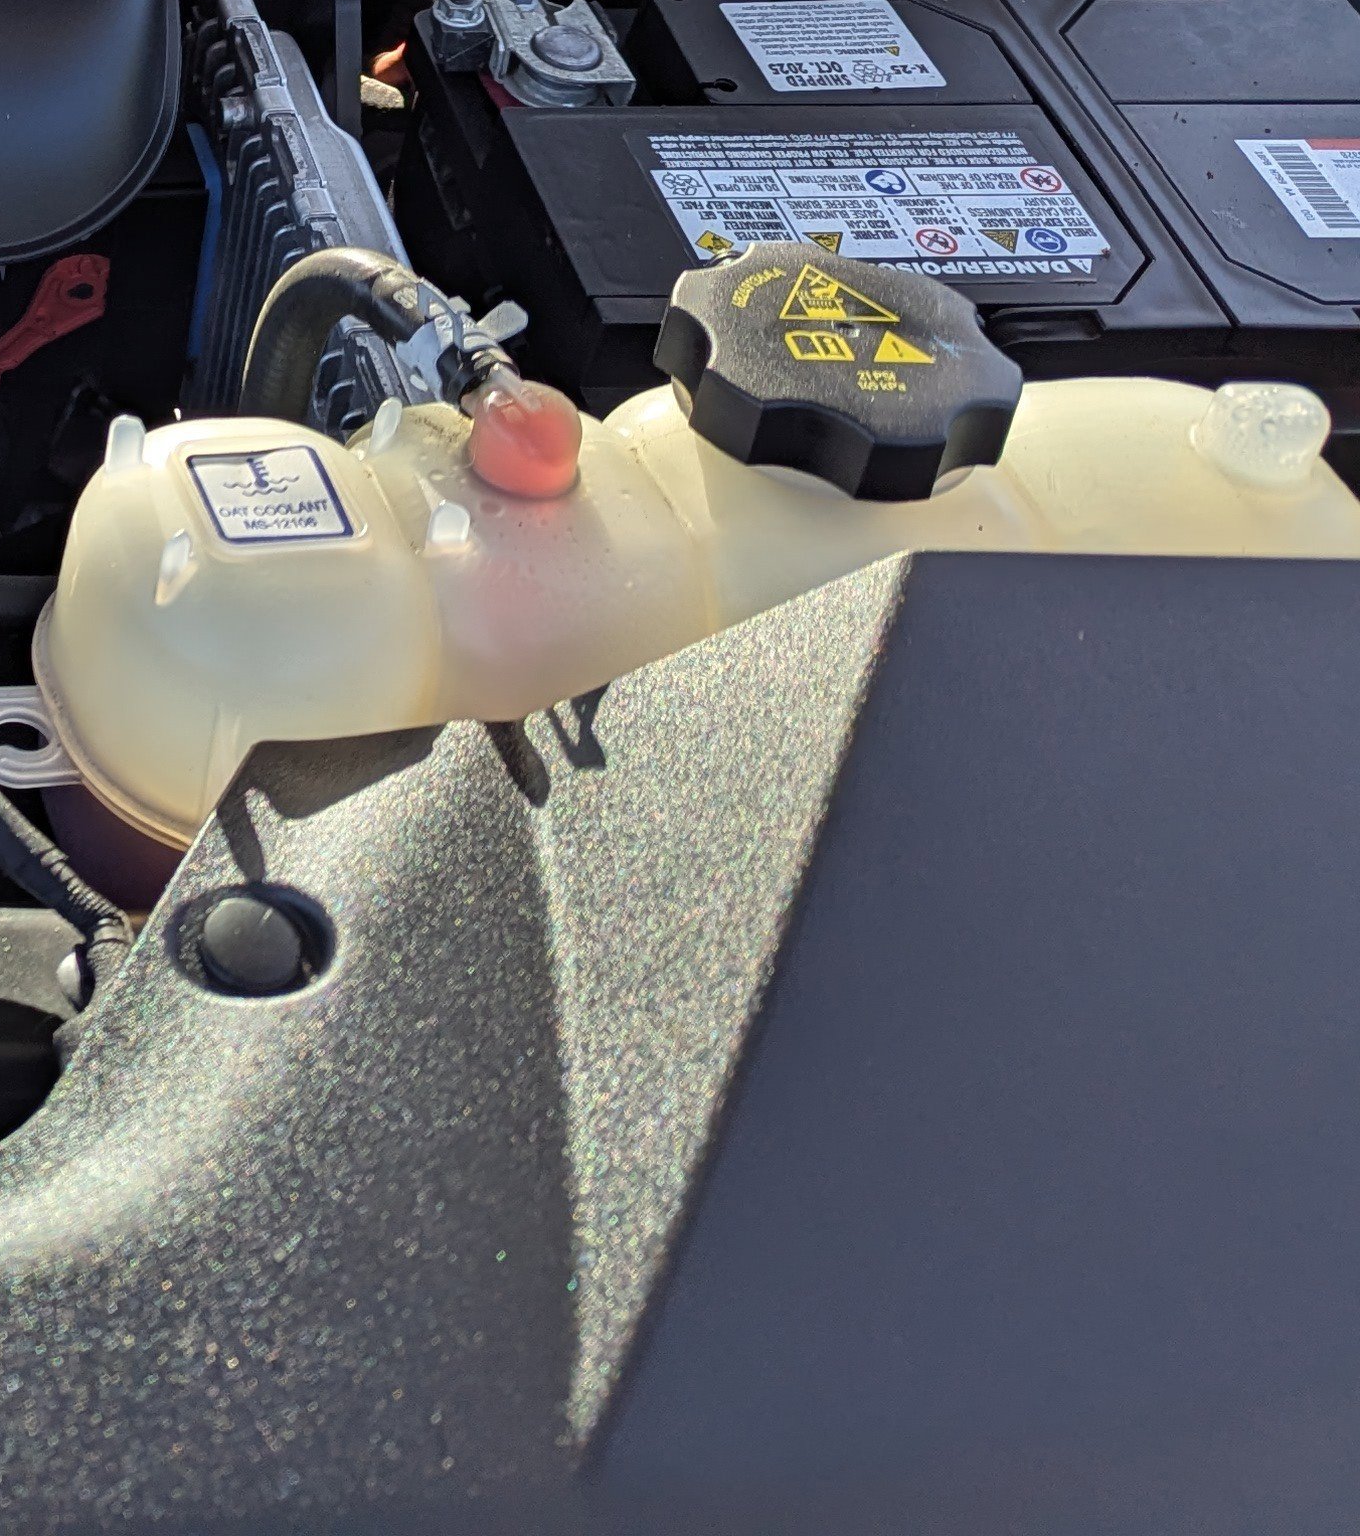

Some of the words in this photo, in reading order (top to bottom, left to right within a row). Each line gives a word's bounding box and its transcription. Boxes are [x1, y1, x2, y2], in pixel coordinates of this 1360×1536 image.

[768, 63, 807, 74] 2025
[809, 61, 843, 73] OCT.
[890, 64, 929, 74] K-25
[786, 74, 852, 86] SHIPPED
[772, 150, 811, 158] PROPER
[872, 148, 918, 156] INVERTED
[917, 148, 937, 156] FOR
[938, 148, 1008, 156] RECOMMENDED
[1008, 147, 1028, 155] NOT
[878, 157, 929, 165] EXPLOSION
[729, 175, 775, 184] BATTERY.
[784, 175, 861, 183] INSTRUCTIONS.
[913, 173, 967, 182] CHILDREN.
[968, 173, 982, 181] OF
[984, 173, 1017, 181] REACH
[713, 183, 740, 192] OPEN
[742, 183, 764, 192] NOT
[765, 183, 781, 192] DO
[818, 183, 836, 192] ALL
[837, 183, 866, 192] READ
[938, 182, 957, 191] THE
[957, 182, 972, 190] OF
[973, 181, 995, 190] OUT
[996, 181, 1021, 189] KEEP
[677, 201, 704, 211] FAST.
[705, 200, 728, 210] HELP
[729, 200, 772, 210] MEDICAL
[782, 200, 820, 210] BURNS.
[822, 199, 859, 209] SEVERE
[860, 199, 878, 208] OR
[894, 198, 938, 207] SMOKING
[1018, 197, 1058, 206] INJURY.
[1060, 197, 1075, 206] OR
[697, 211, 716, 220] GET
[755, 210, 779, 219] WITH
[793, 210, 849, 219] BLINDNESS
[849, 210, 884, 219] CAUSE
[906, 207, 943, 216] FLAMES
[968, 207, 1024, 217] BLINDNESS
[1025, 207, 1059, 216] CAUSE
[1060, 207, 1082, 216] CAN
[723, 220, 785, 230] IMMEDIATELY
[845, 219, 866, 229] CAN
[867, 219, 890, 229] ACID
[912, 216, 949, 225] SPARKS
[978, 218, 1010, 228] GASES
[1012, 217, 1063, 228] EXPLOSIVE
[1065, 217, 1089, 227] EYES
[850, 229, 898, 240] SULFURIC
[948, 226, 965, 235] NO
[1061, 227, 1097, 237] SHIELD
[734, 231, 759, 241] EYES
[760, 231, 793, 240] FLUSH
[868, 260, 1071, 275] DANGER/POISO
[218, 506, 249, 518] OAT
[252, 499, 328, 516] COOLANT
